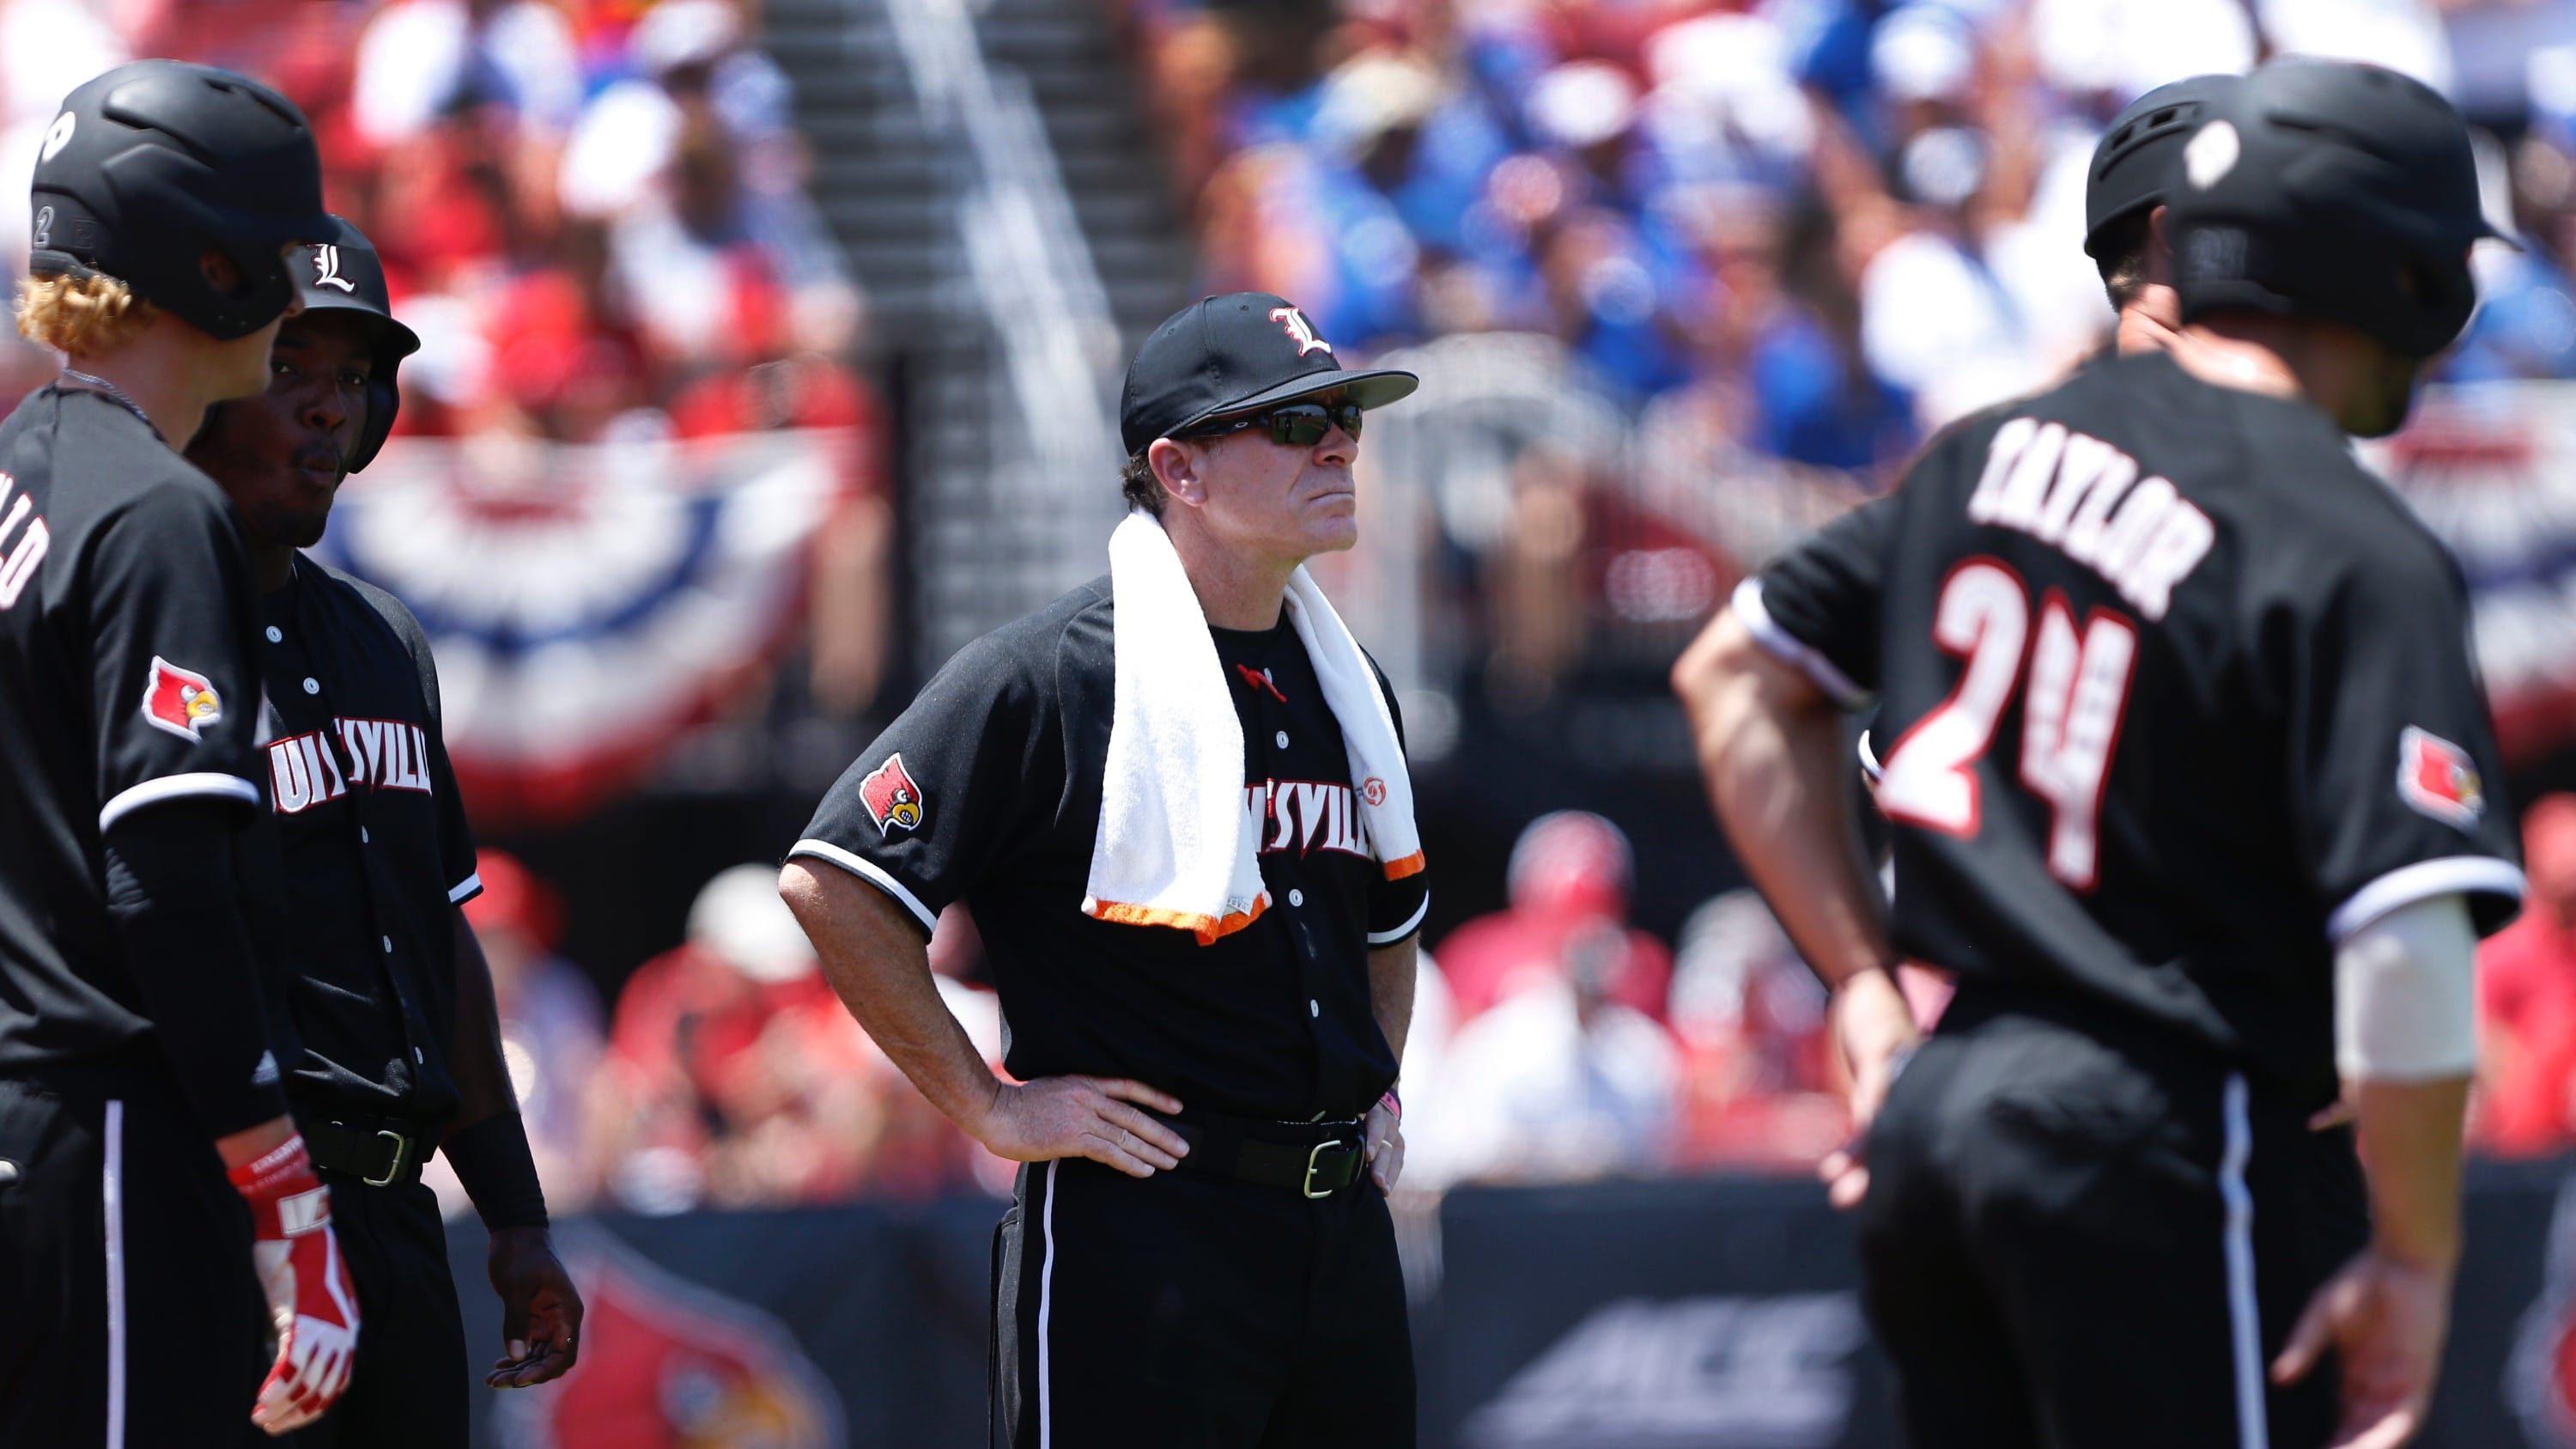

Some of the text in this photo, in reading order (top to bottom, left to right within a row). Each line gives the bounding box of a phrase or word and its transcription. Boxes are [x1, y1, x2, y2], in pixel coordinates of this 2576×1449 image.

[307, 242, 358, 295] L
[1269, 307, 1334, 357] L
[1966, 417, 2215, 624] TAYLOR
[1876, 553, 2141, 893] 24
